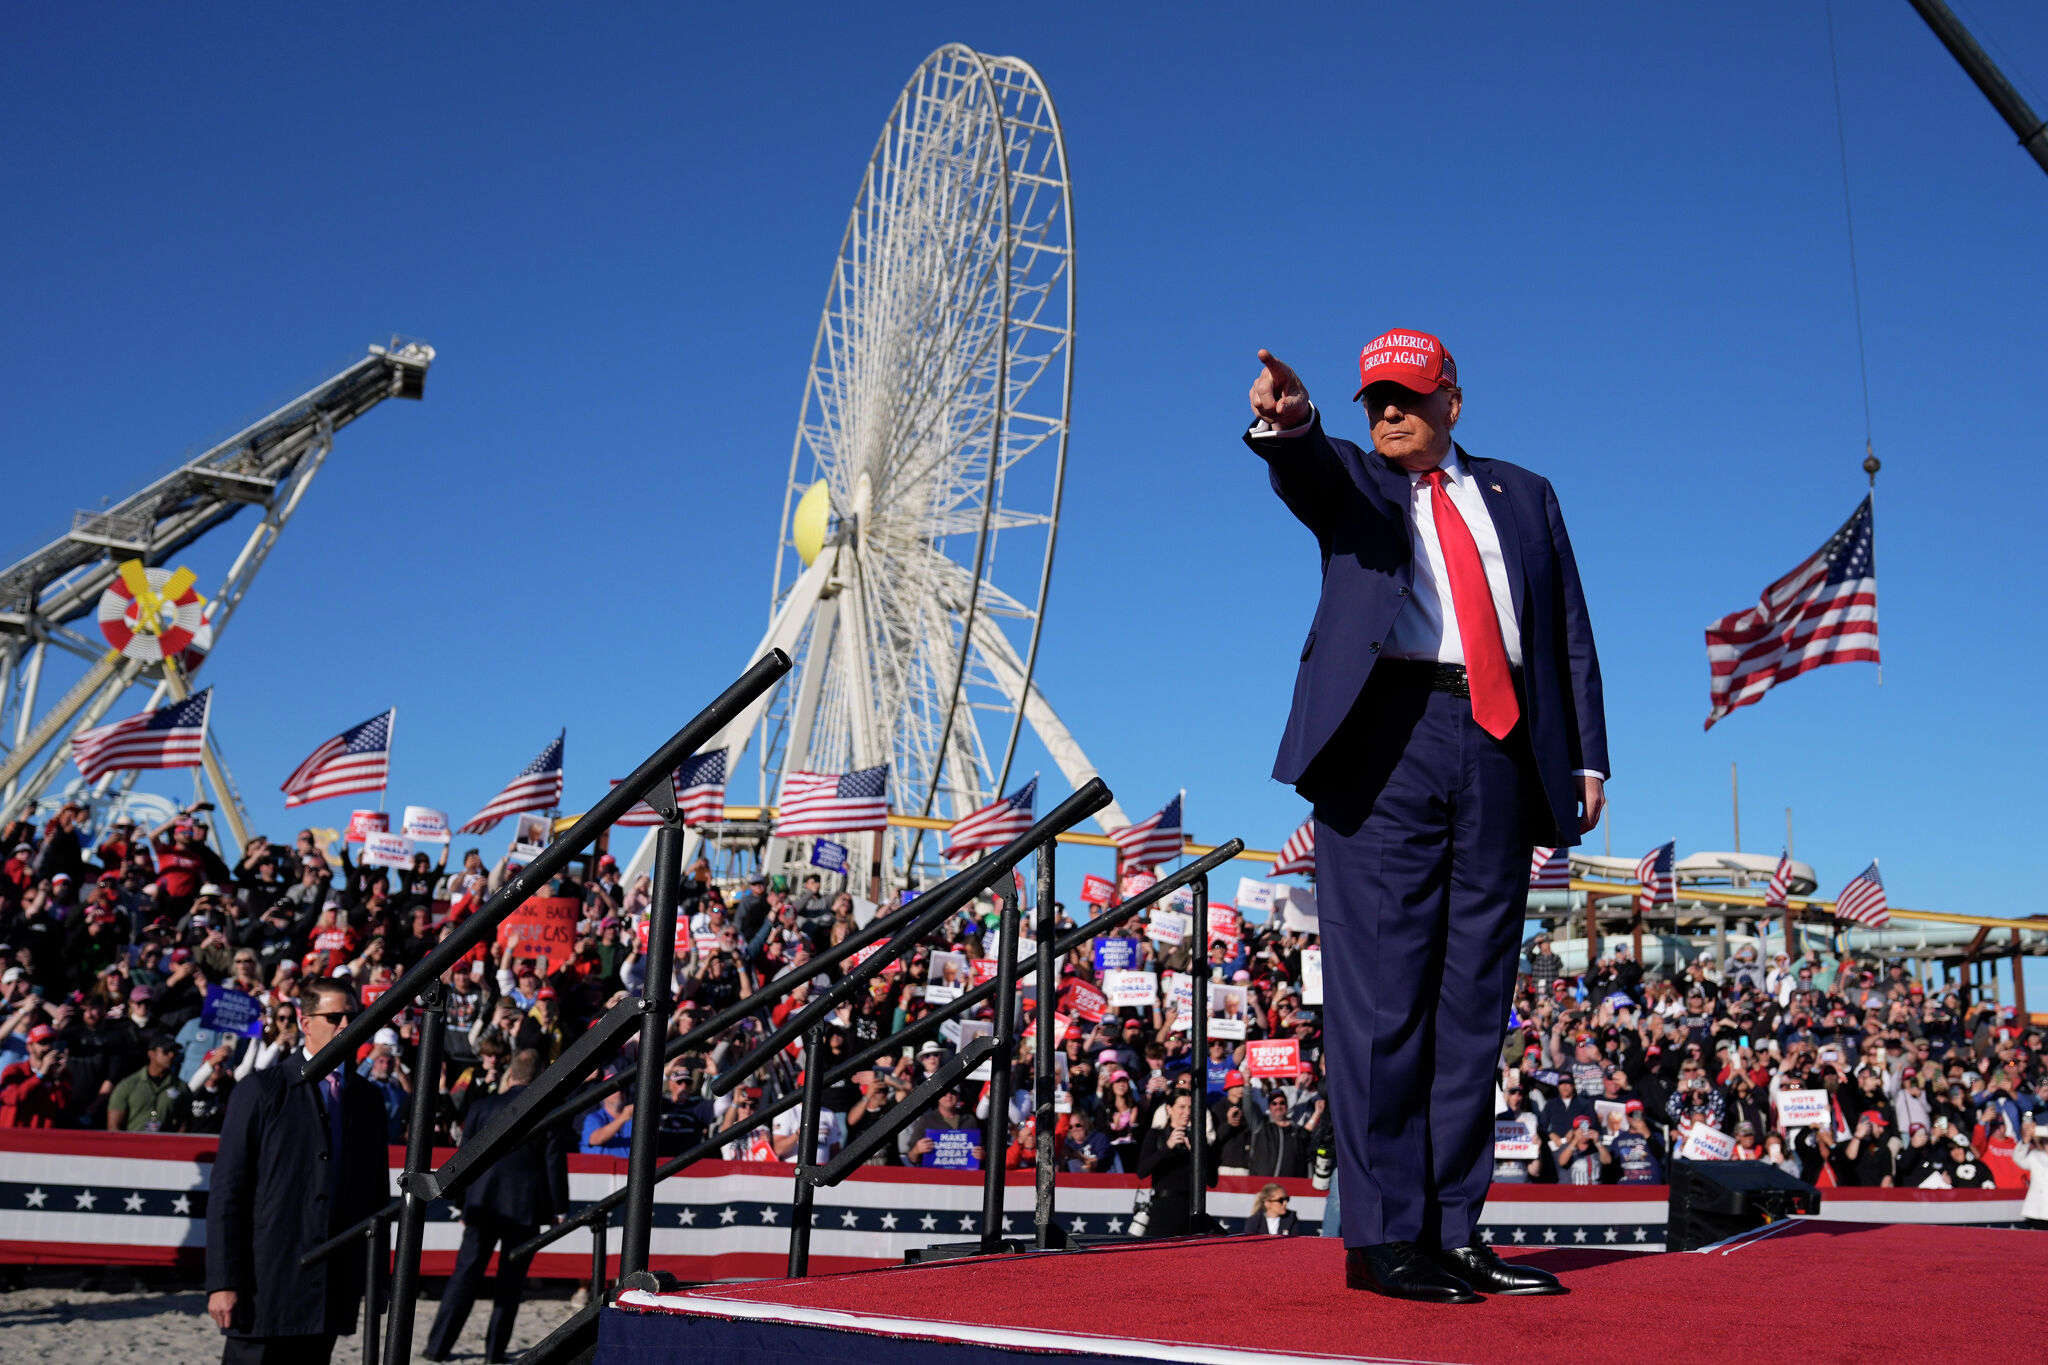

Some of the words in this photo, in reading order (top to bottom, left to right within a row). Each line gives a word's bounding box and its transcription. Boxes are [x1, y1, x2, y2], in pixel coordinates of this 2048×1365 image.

[1362, 337, 1384, 357] MAKE
[1385, 334, 1434, 352] AMERICA
[1365, 352, 1392, 371] GREAT
[1393, 351, 1428, 368] AGAIN
[416, 815, 439, 823] VOTE
[379, 838, 403, 846] VOTE
[370, 844, 409, 854] DONALD
[373, 852, 406, 861] TRUMP
[546, 906, 573, 919] BACK
[1099, 946, 1134, 954] AMERICA
[1113, 984, 1153, 992] DONALD
[1075, 985, 1106, 1004] TRUMP
[1075, 994, 1101, 1012] 2024
[1251, 1046, 1295, 1058] TRUMP
[1256, 1055, 1289, 1067] 2024
[1783, 1103, 1825, 1112] DONALD
[1788, 1111, 1822, 1119] TRUMP
[1498, 1126, 1524, 1134] VOTE
[940, 1133, 968, 1142] MAKE
[1495, 1135, 1532, 1143] ONALD
[1705, 1134, 1728, 1148] VOTE
[1693, 1137, 1729, 1157] DONALD
[935, 1149, 969, 1157] GREAT
[932, 1157, 968, 1165] AGAIN!
